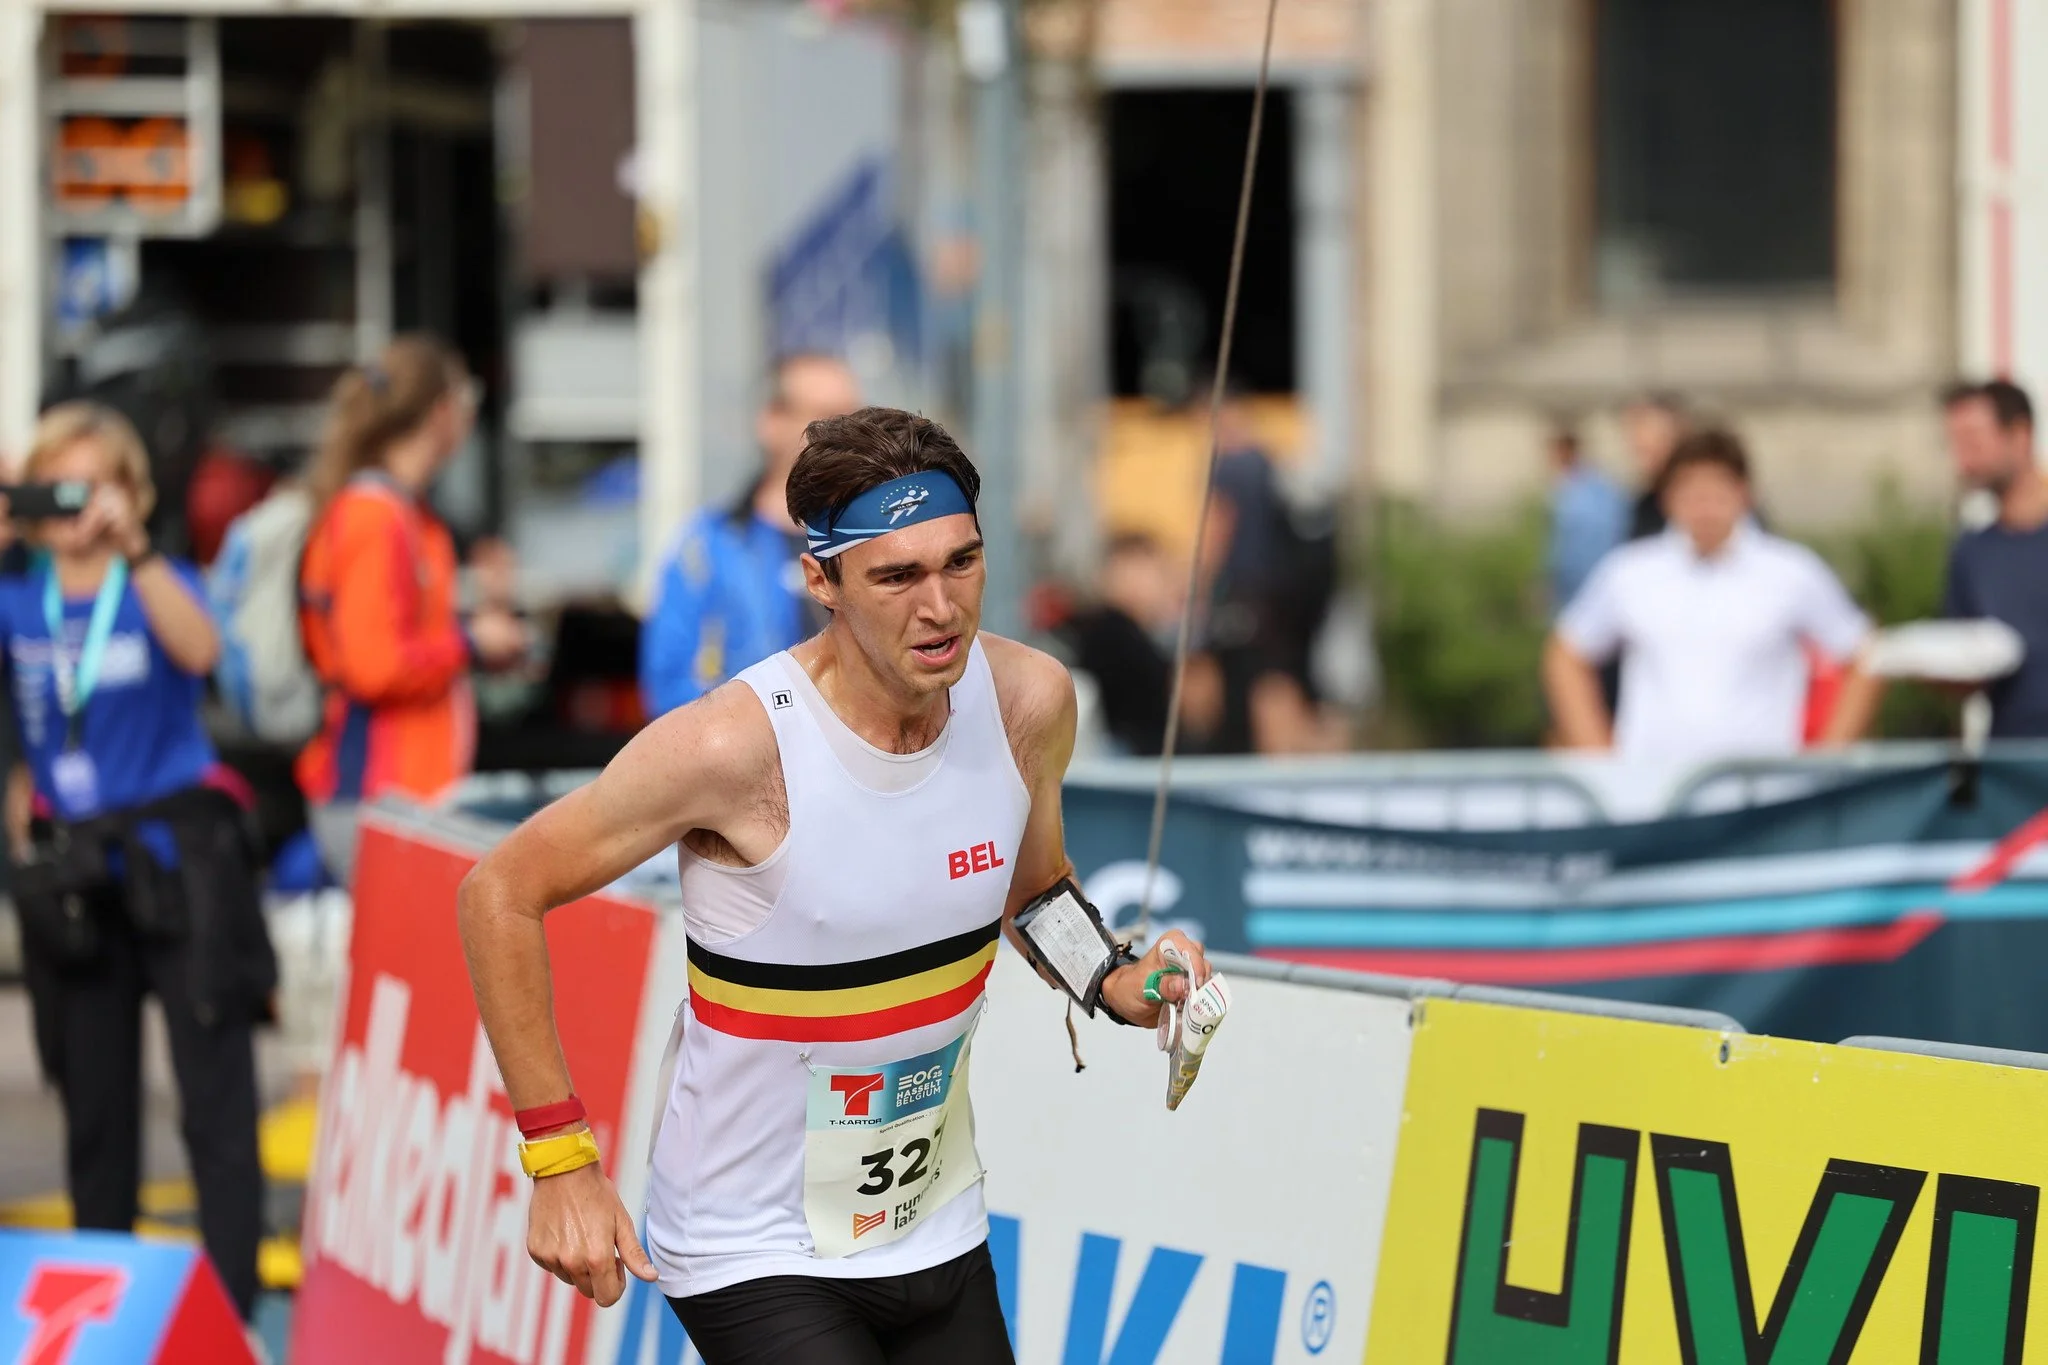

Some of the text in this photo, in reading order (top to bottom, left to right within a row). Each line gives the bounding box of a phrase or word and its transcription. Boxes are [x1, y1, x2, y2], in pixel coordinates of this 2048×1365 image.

[948, 841, 1004, 880] BEL
[896, 1078, 942, 1100] HASSELT
[896, 1086, 941, 1107] BELGIUM
[829, 1118, 882, 1126] T-KARTOR
[894, 1209, 917, 1230] lab
